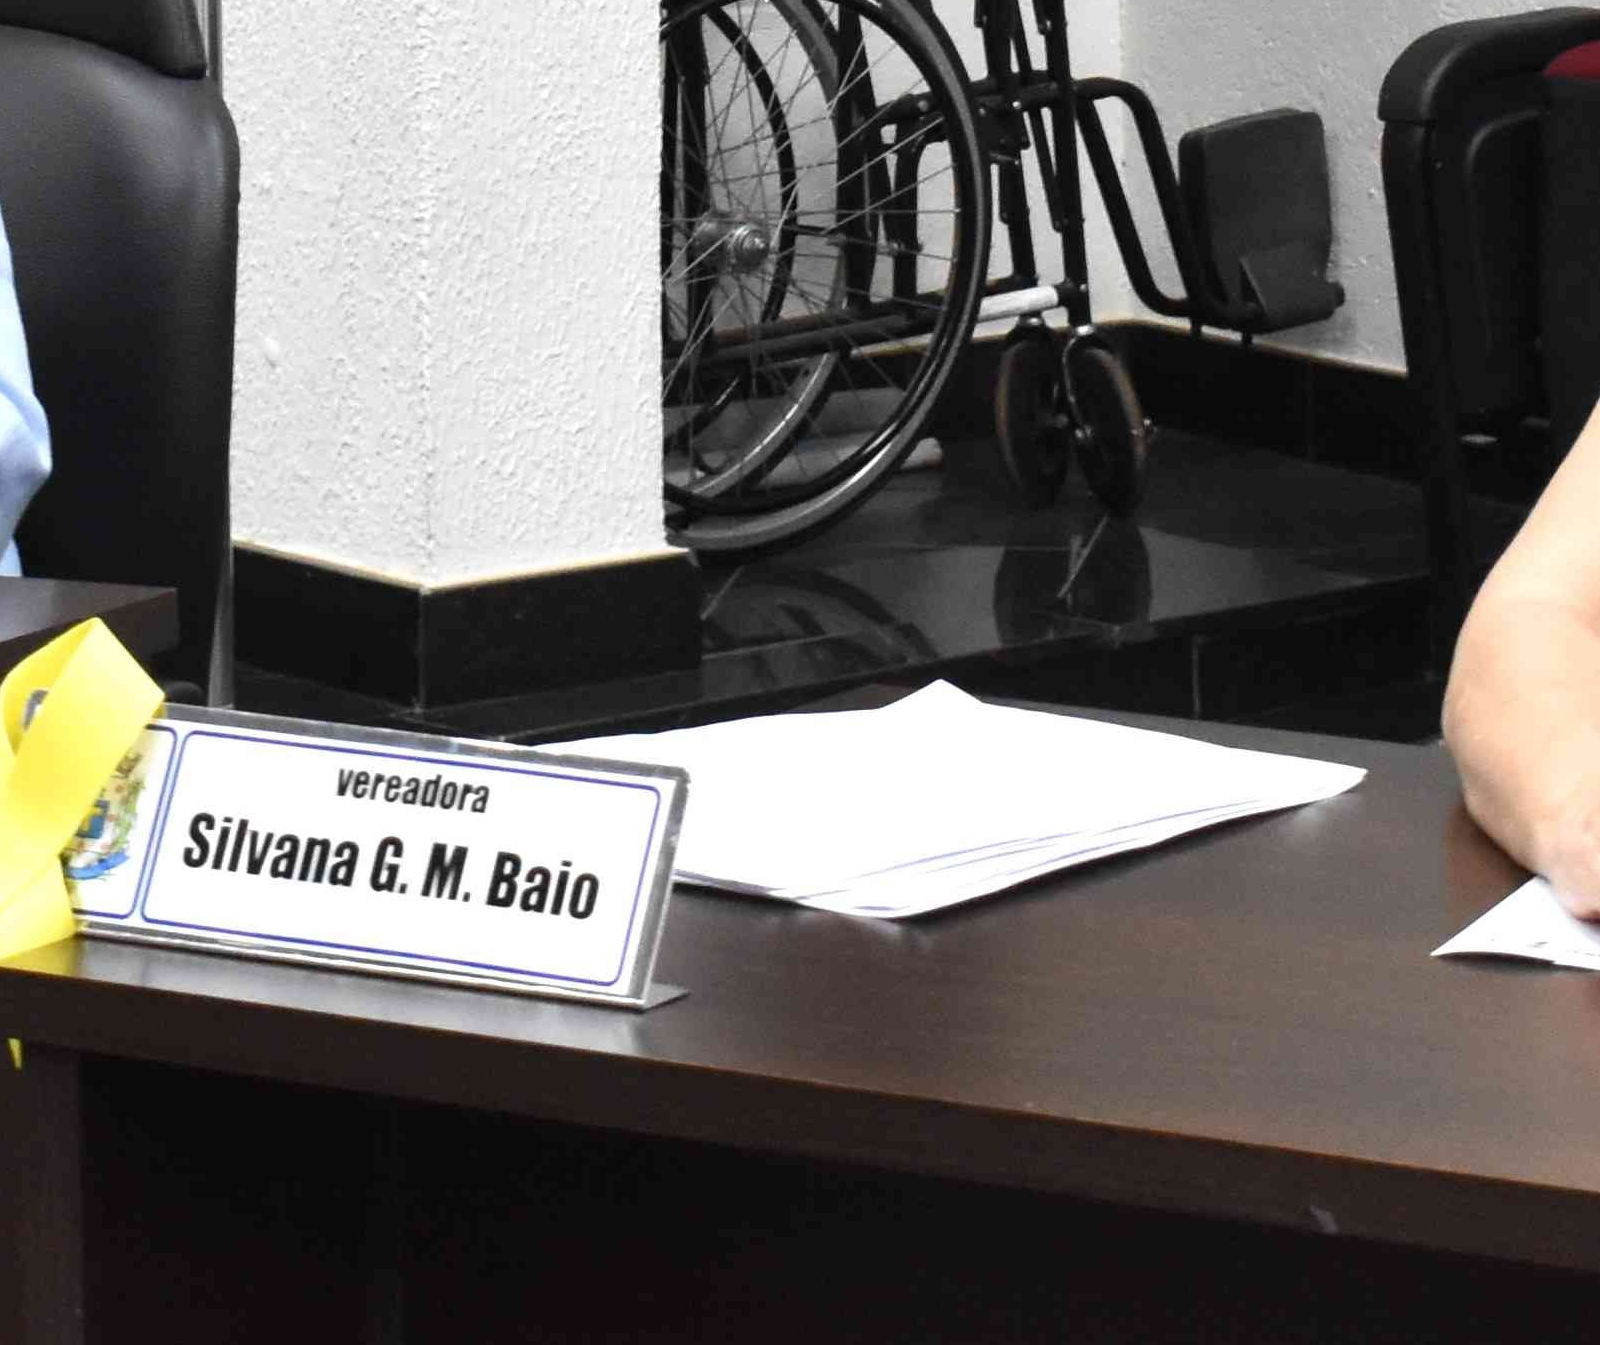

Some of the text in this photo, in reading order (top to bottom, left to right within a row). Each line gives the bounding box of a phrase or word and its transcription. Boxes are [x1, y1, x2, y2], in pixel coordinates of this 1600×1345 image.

[336, 769, 490, 813] vereadora
[183, 812, 599, 920] Silvana G. M. Baio
